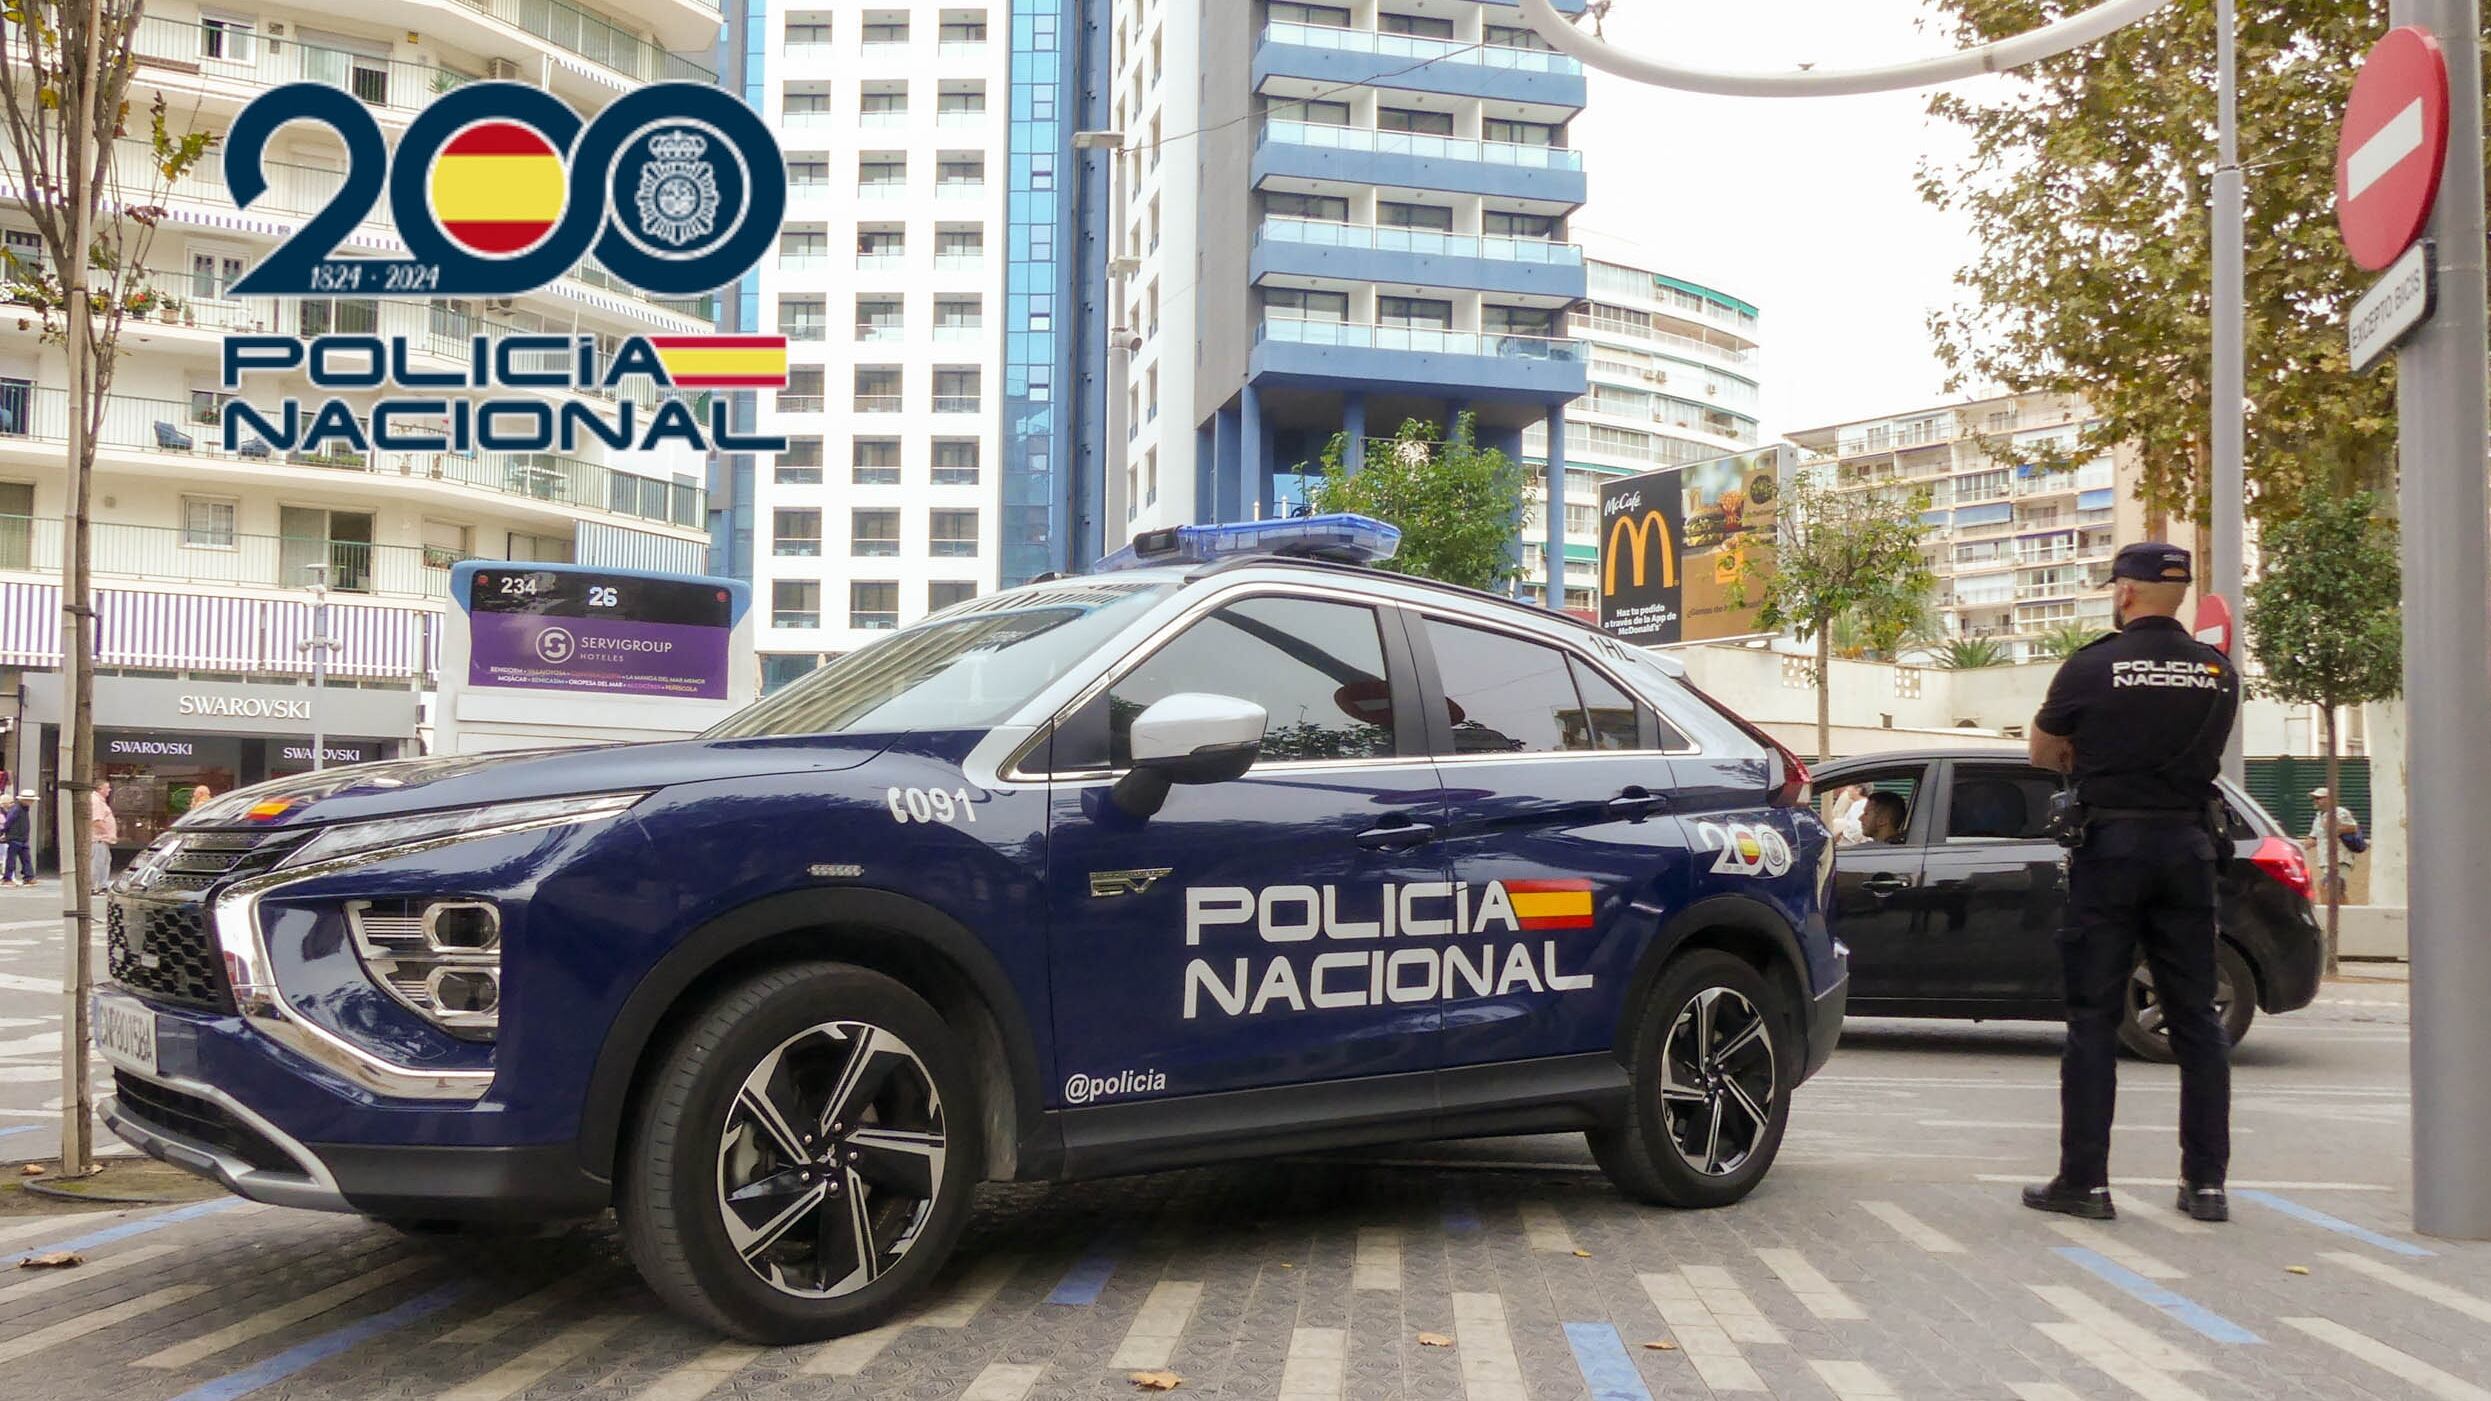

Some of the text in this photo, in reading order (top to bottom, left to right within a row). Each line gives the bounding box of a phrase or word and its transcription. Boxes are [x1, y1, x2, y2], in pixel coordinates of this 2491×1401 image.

[2352, 269, 2420, 350] EXCEPTO BICIS
[1604, 491, 1642, 516] McCafé
[501, 577, 537, 595] 234
[589, 586, 618, 607] 26
[1610, 617, 1632, 627] través
[1633, 616, 1643, 624] de
[1643, 615, 1650, 623] la
[1651, 614, 1666, 624] App
[1667, 612, 1677, 621] de
[1616, 604, 1665, 617] Haz tu pedido
[581, 636, 673, 653] SERVIGROUP
[580, 653, 624, 663] HOTELES
[2113, 673, 2229, 692] NACIONA
[179, 695, 311, 719] SWAROVSKI
[111, 740, 192, 755] SWAROVSKI
[906, 787, 977, 824] 091
[1183, 940, 1594, 1019] NACIONAL
[1065, 1068, 1166, 1104] @policia
